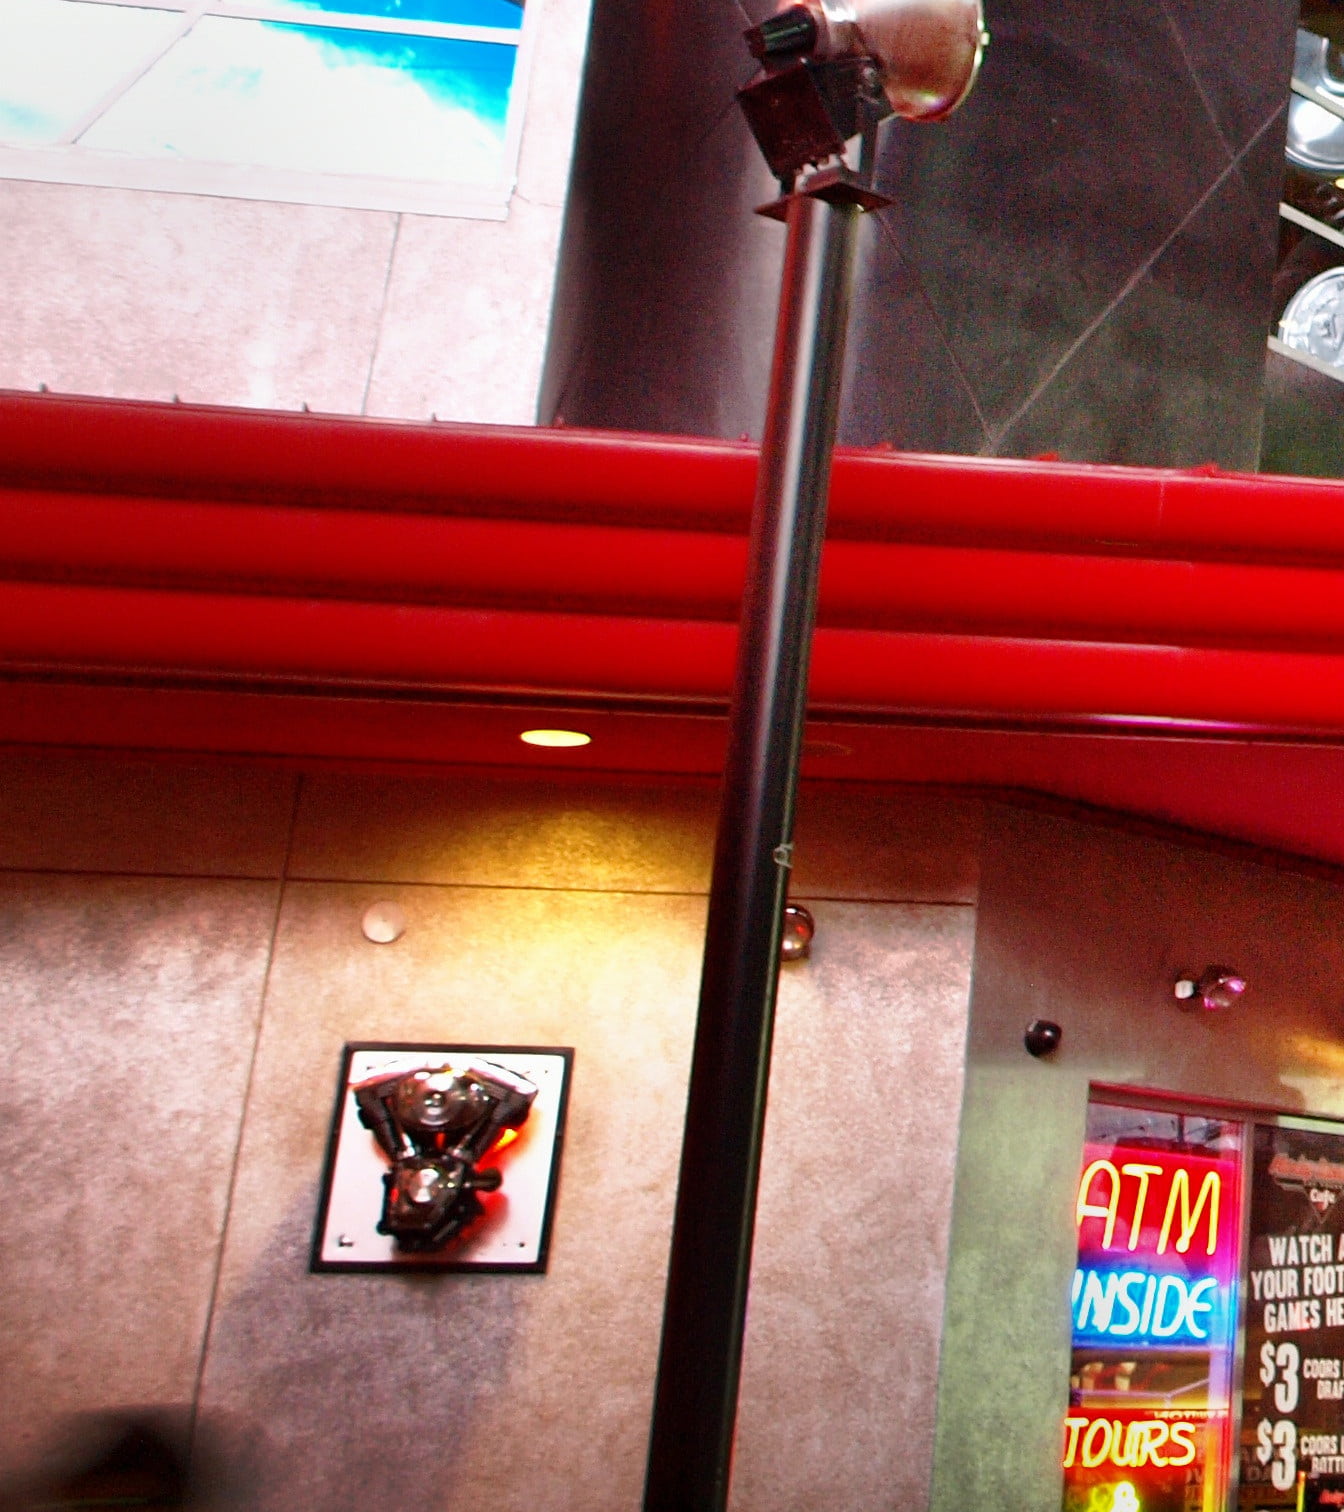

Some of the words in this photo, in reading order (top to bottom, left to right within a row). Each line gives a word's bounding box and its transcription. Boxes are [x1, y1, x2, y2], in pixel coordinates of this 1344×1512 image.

[1076, 1159, 1221, 1256] ATM
[1268, 1234, 1333, 1267] WATCH
[1251, 1268, 1299, 1301] YOUR
[1264, 1299, 1321, 1334] GAMES
[1259, 1340, 1299, 1414] $3
[1303, 1358, 1341, 1379] COORS
[1063, 1416, 1197, 1468] TOURS
[1256, 1418, 1297, 1491] $3
[1300, 1435, 1338, 1456] COORS
